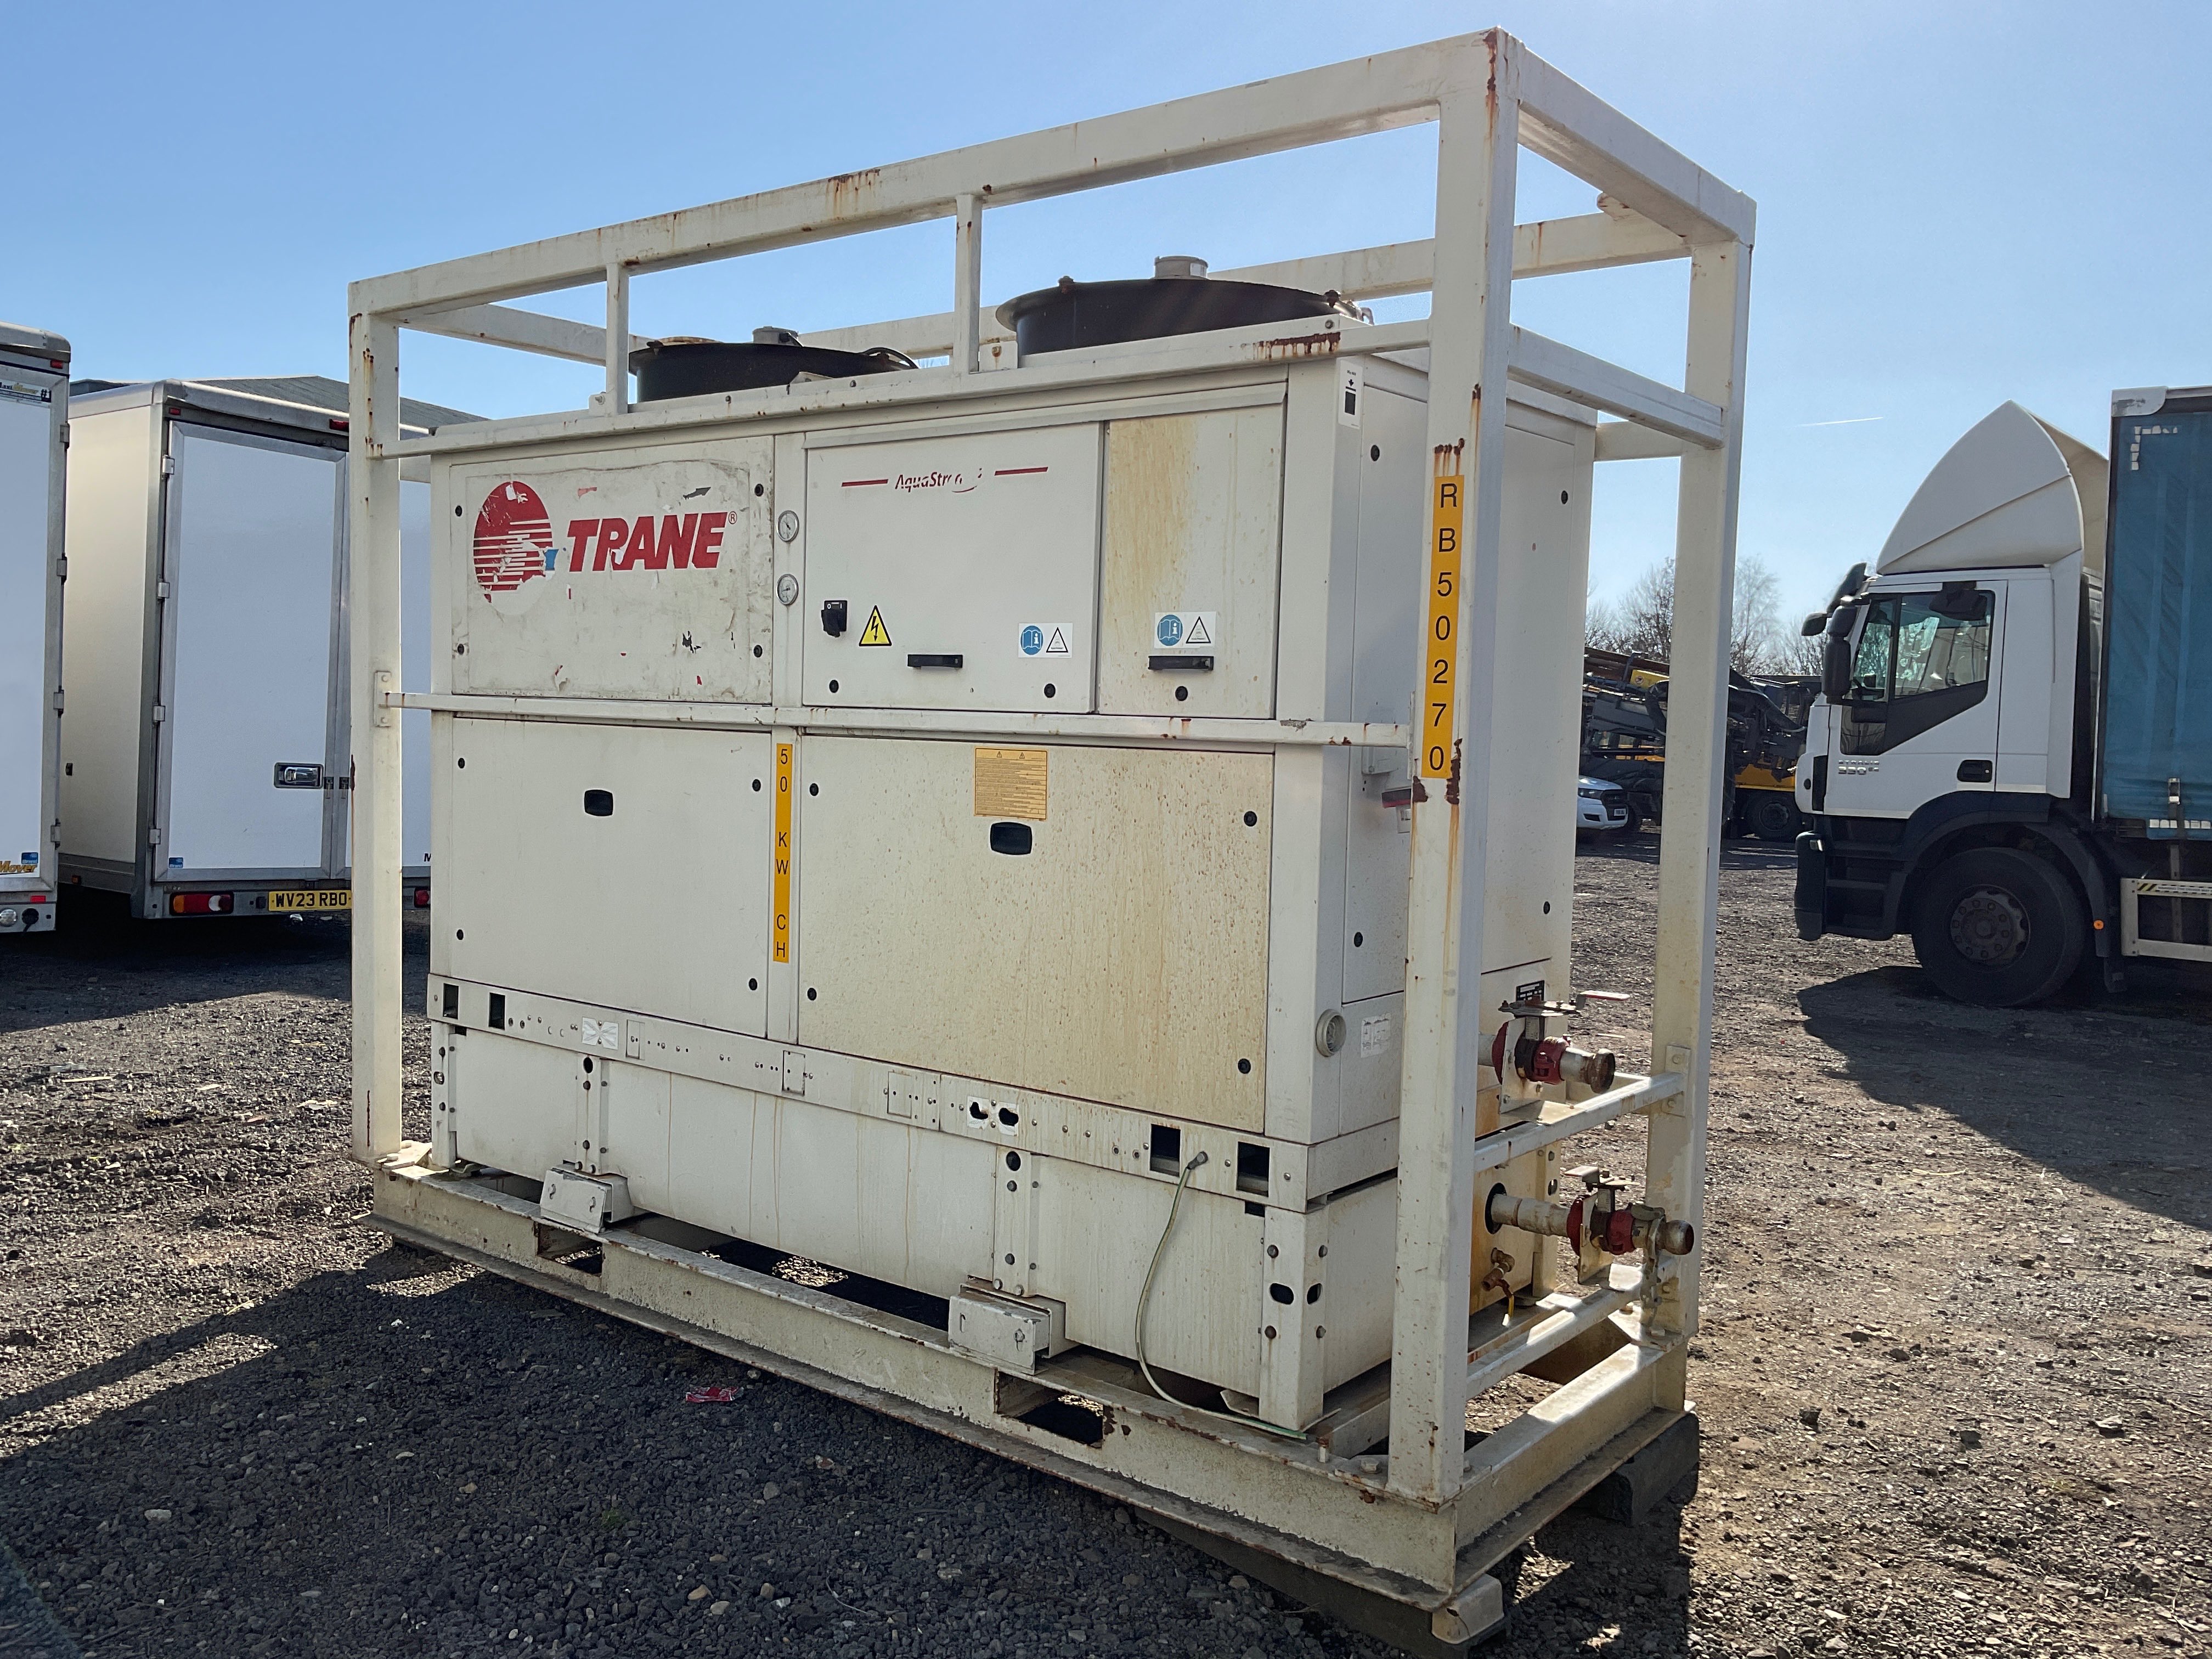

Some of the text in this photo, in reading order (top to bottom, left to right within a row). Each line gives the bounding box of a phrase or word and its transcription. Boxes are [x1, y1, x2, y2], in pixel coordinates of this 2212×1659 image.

[1429, 483, 1458, 771] RB50270
[276, 892, 347, 907] WV23 RBO
[776, 748, 789, 958] 50 KW CH
